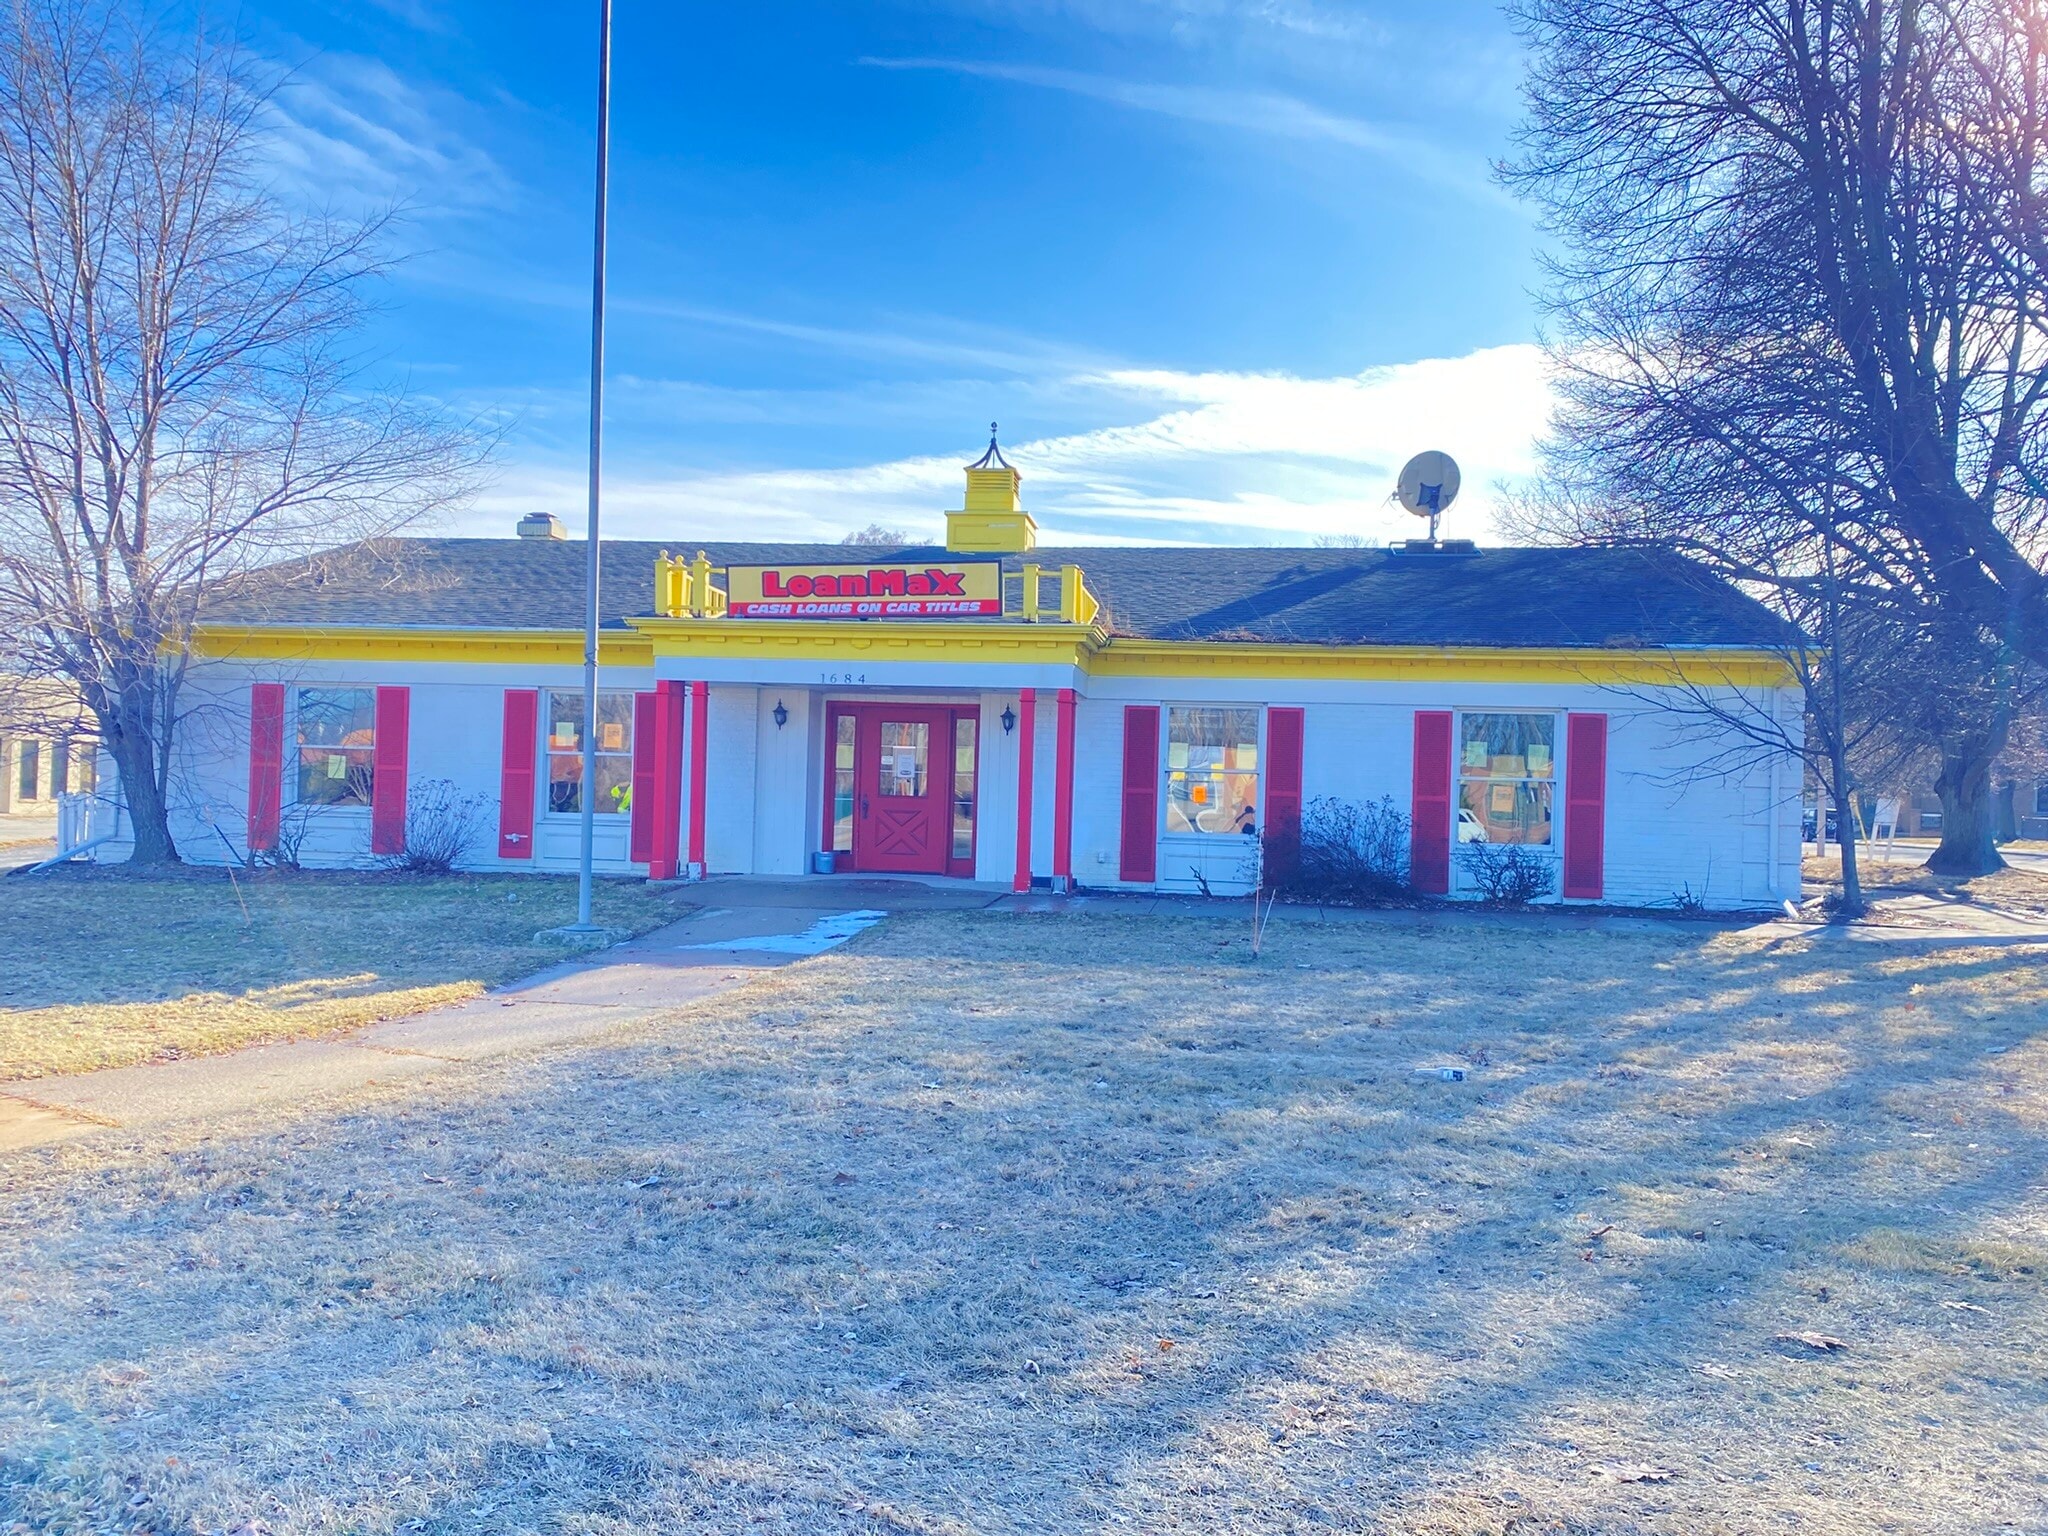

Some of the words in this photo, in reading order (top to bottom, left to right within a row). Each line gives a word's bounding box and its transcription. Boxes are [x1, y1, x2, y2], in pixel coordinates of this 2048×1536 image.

[762, 569, 966, 597] LoanMax
[747, 604, 792, 614] CASH
[796, 603, 852, 614] LOANS
[857, 603, 881, 613] ON
[886, 603, 921, 613] CAR
[926, 602, 981, 612] TITLES
[821, 673, 865, 684] 1684
